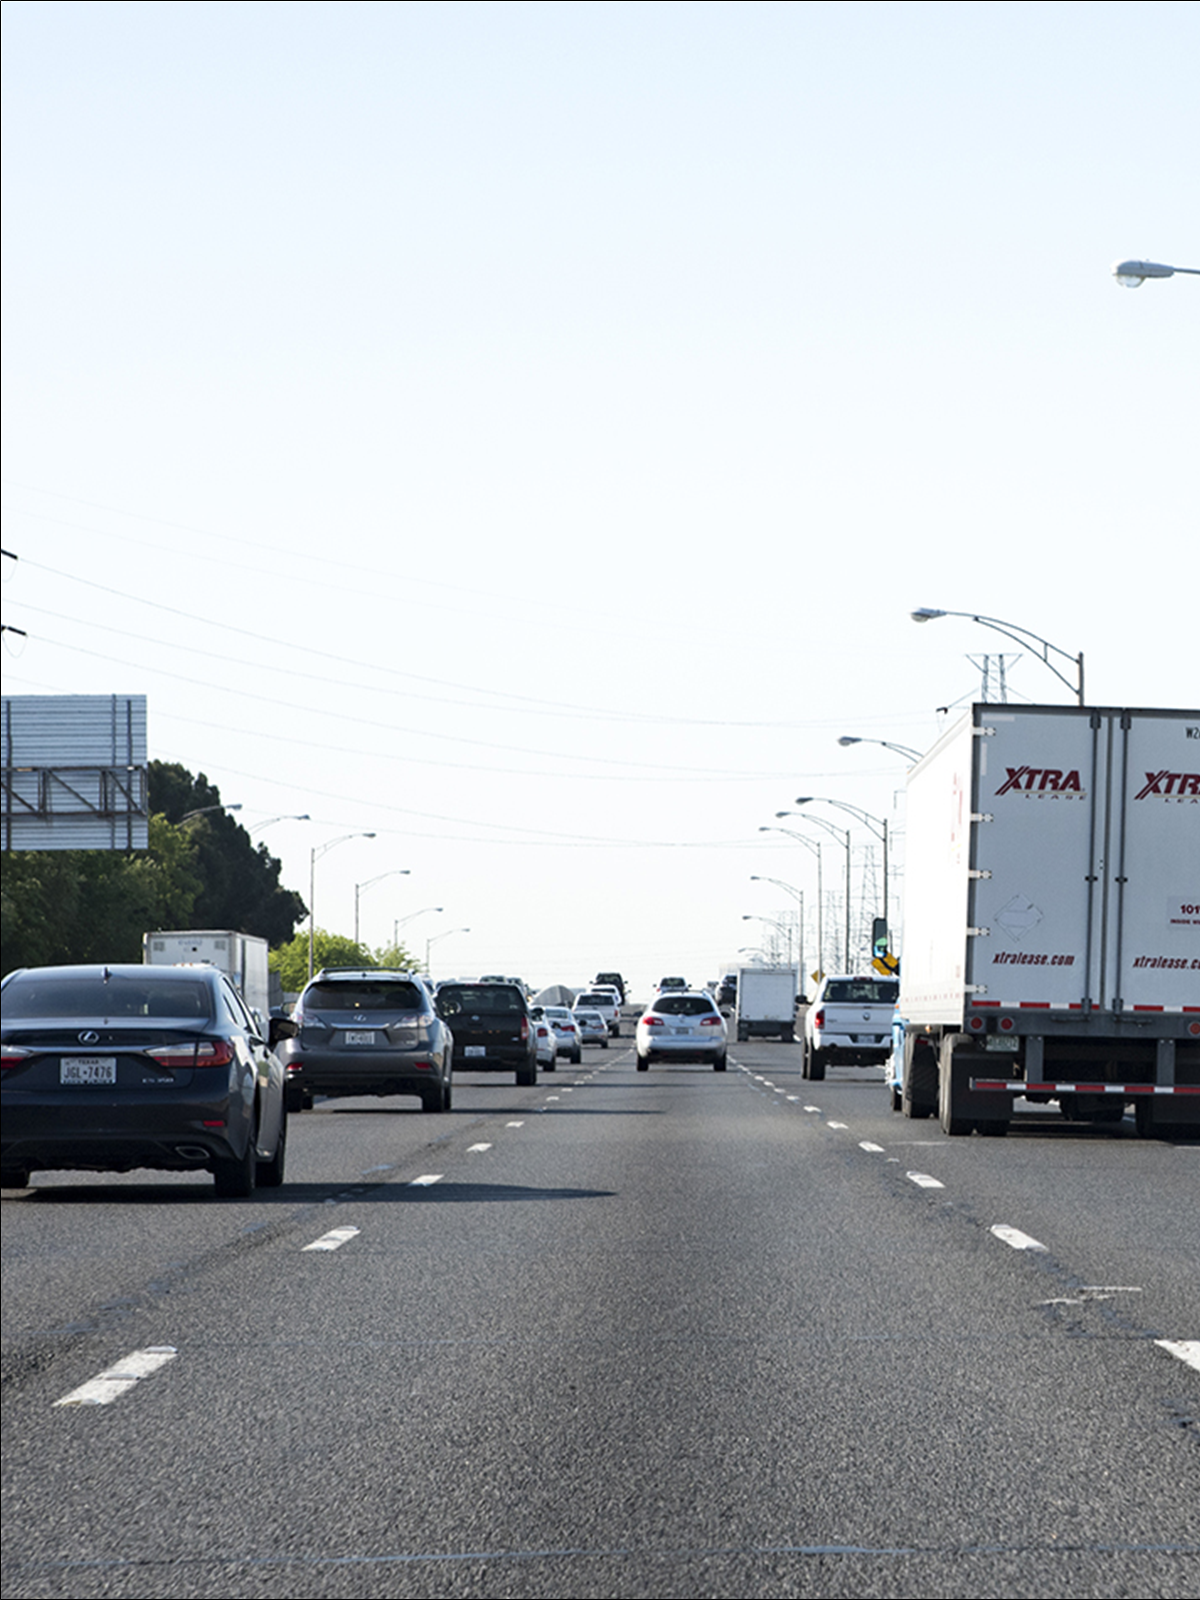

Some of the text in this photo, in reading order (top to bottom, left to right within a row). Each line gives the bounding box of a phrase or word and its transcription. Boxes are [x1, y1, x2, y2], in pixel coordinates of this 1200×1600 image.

[994, 766, 1082, 796] XTRA
[1025, 793, 1088, 801] LEASE
[992, 951, 1075, 967] xtralease.com
